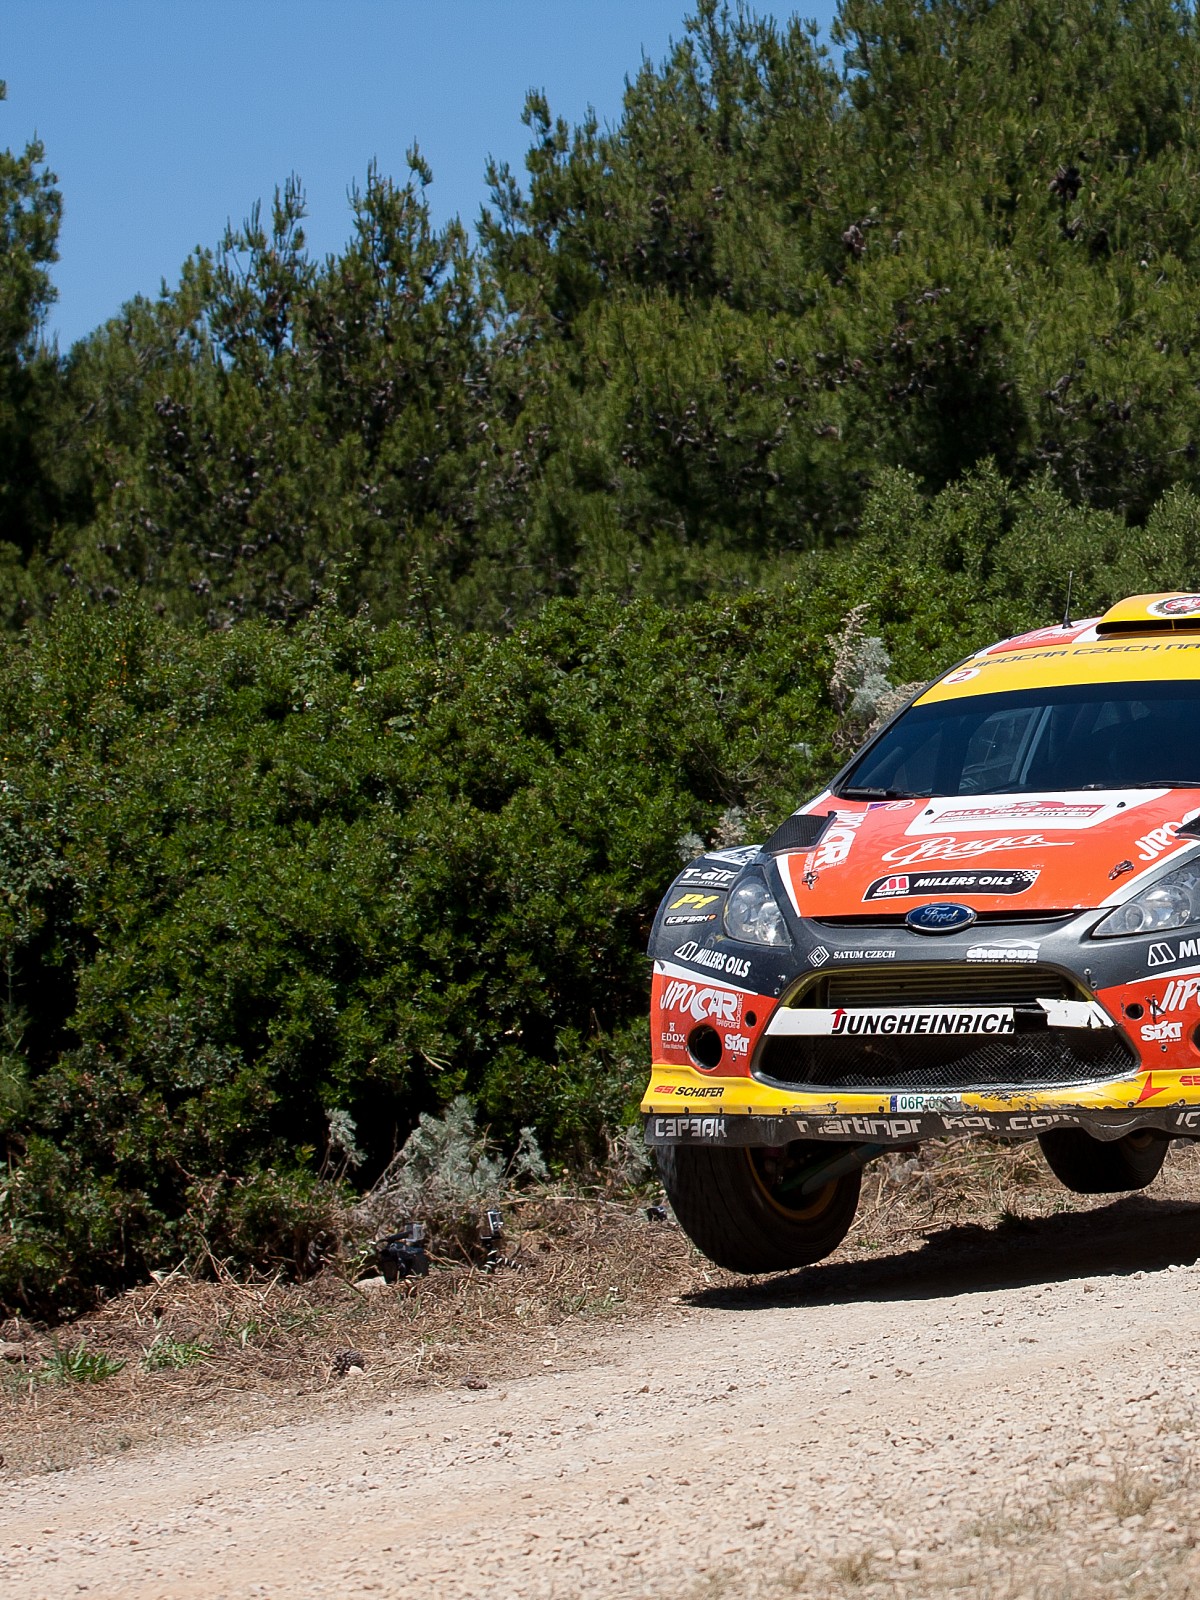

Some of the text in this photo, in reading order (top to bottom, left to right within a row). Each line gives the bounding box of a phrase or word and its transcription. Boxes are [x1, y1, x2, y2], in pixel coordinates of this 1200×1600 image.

[963, 651, 1068, 670] JIPOCAR
[1073, 645, 1160, 655] CZECH
[914, 876, 1014, 888] MILLERS OILS
[669, 893, 719, 909] P1
[920, 907, 959, 922] Ford
[833, 950, 896, 959] SATUM CZECH
[691, 948, 751, 978] MILLERS OILS
[832, 1013, 1015, 1034] JUNGHEINRICH
[661, 1032, 686, 1043] EDOX
